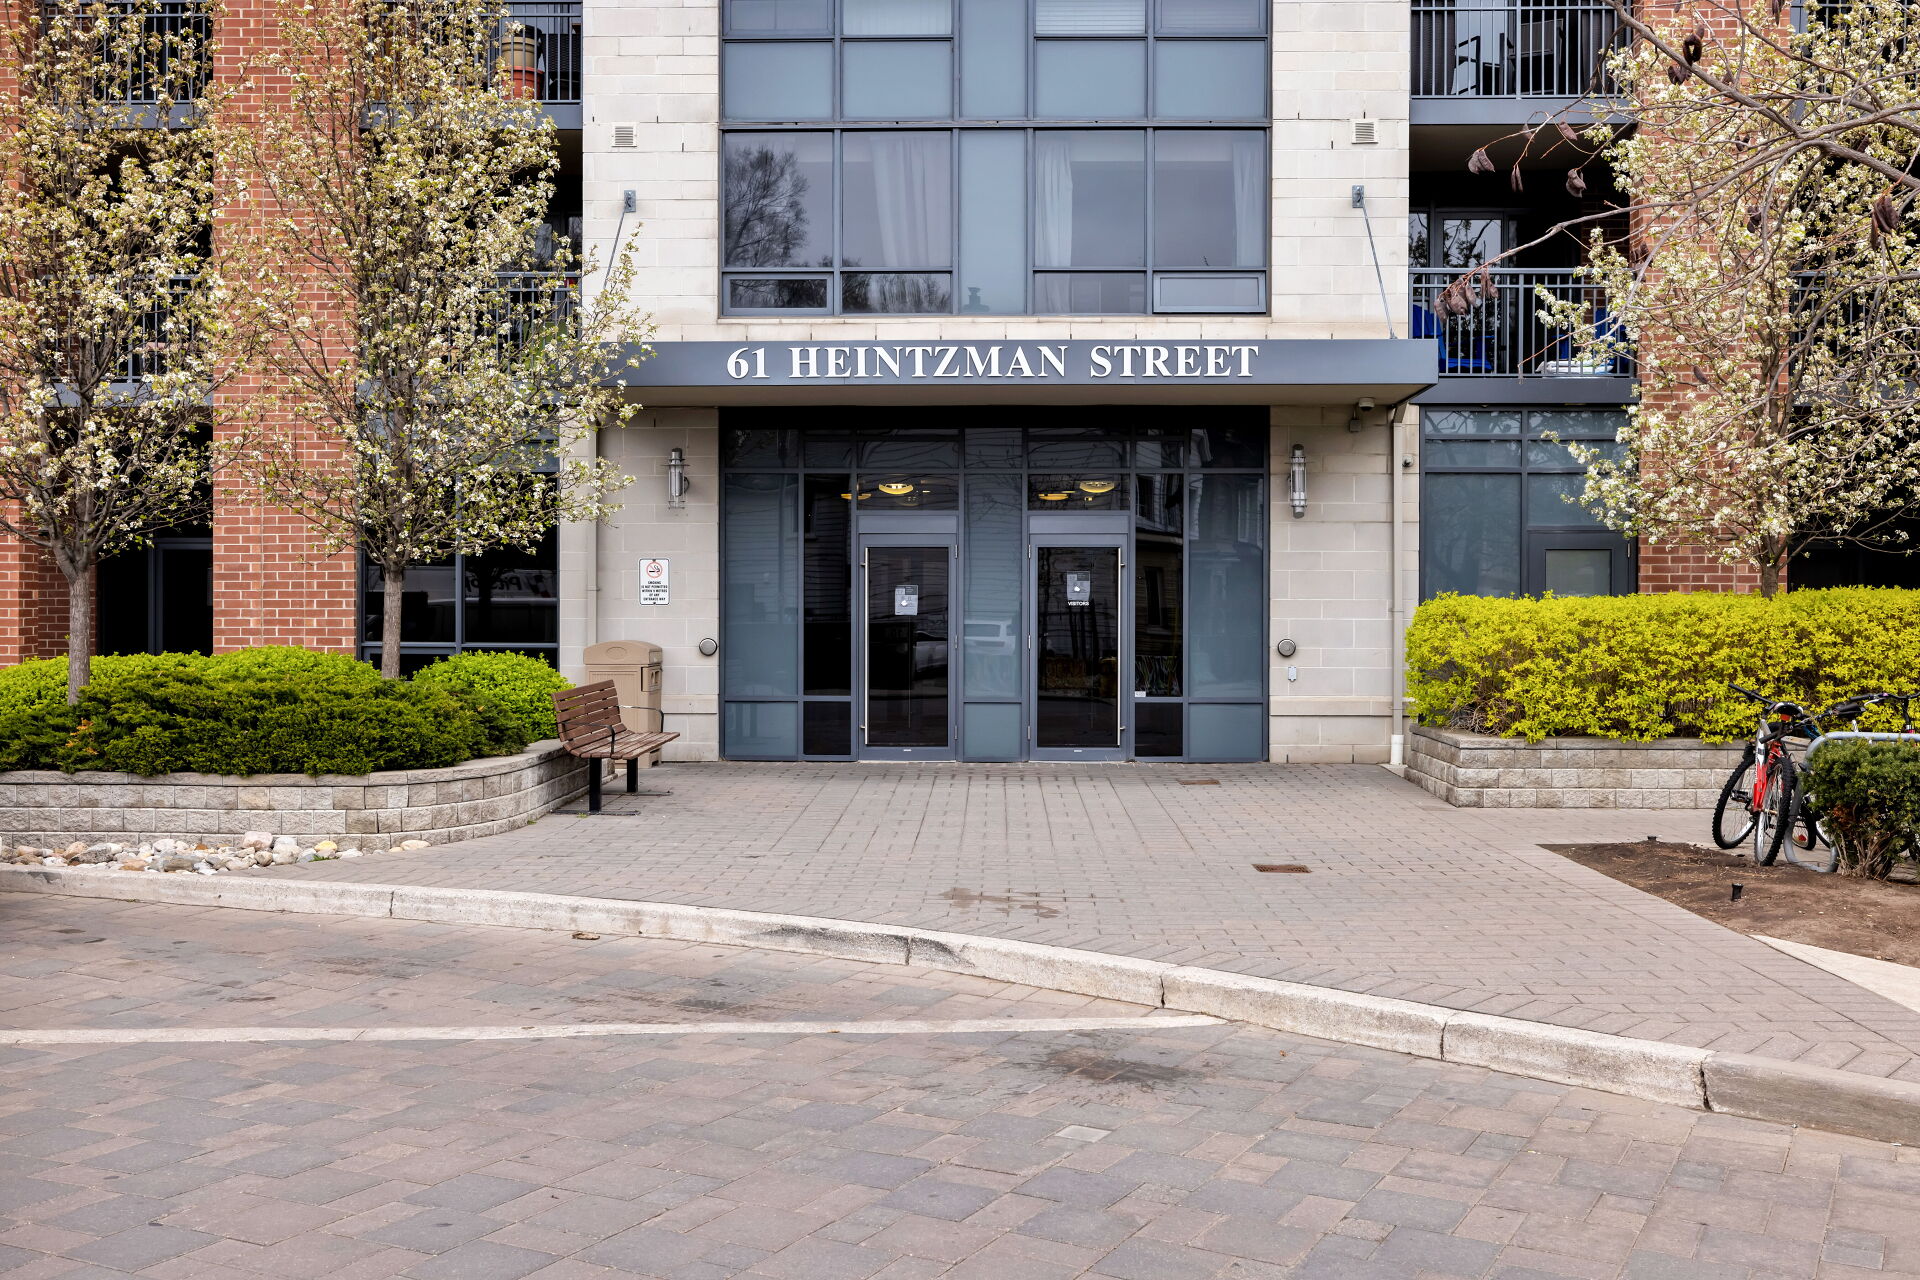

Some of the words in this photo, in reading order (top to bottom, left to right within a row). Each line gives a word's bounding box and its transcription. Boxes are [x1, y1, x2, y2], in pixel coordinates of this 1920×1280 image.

[726, 347, 769, 379] 61
[788, 345, 1069, 378] HEINTZMAN
[1089, 345, 1260, 378] STREET
